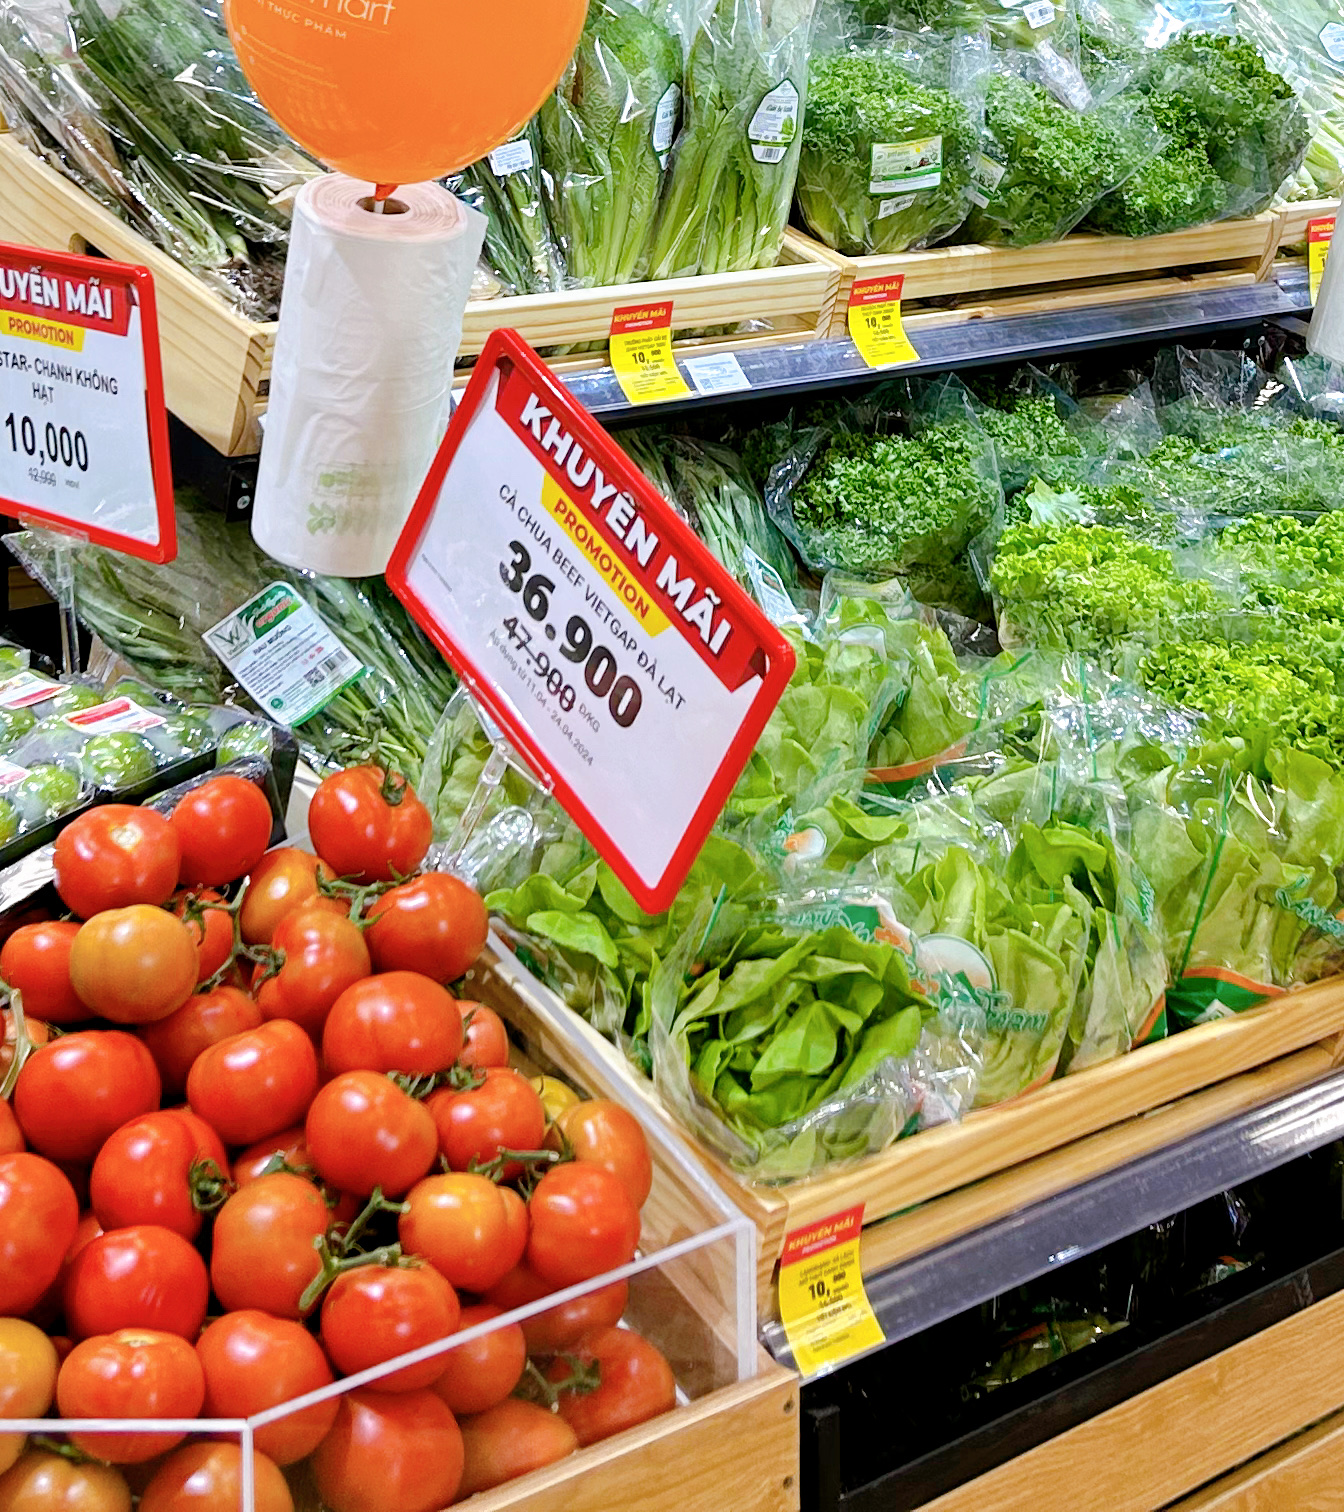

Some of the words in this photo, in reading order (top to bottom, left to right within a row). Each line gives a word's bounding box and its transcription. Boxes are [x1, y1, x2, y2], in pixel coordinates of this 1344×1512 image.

[66, 276, 113, 320] MÃI
[9, 317, 74, 346] PROMOTION
[32, 381, 55, 406] HẠT
[34, 356, 73, 384] CHANH
[76, 368, 119, 395] KHÔNG
[5, 412, 89, 473] 10,000
[554, 497, 650, 620] PROMOTION
[499, 485, 517, 511] CÀ
[518, 509, 551, 555] CHUA
[552, 548, 586, 589] BEEF
[584, 584, 639, 652] VIETGAP
[637, 648, 657, 681] ĐÀ
[658, 675, 686, 711] LẠT
[656, 554, 732, 655] MÃI
[499, 540, 643, 729] 36.900
